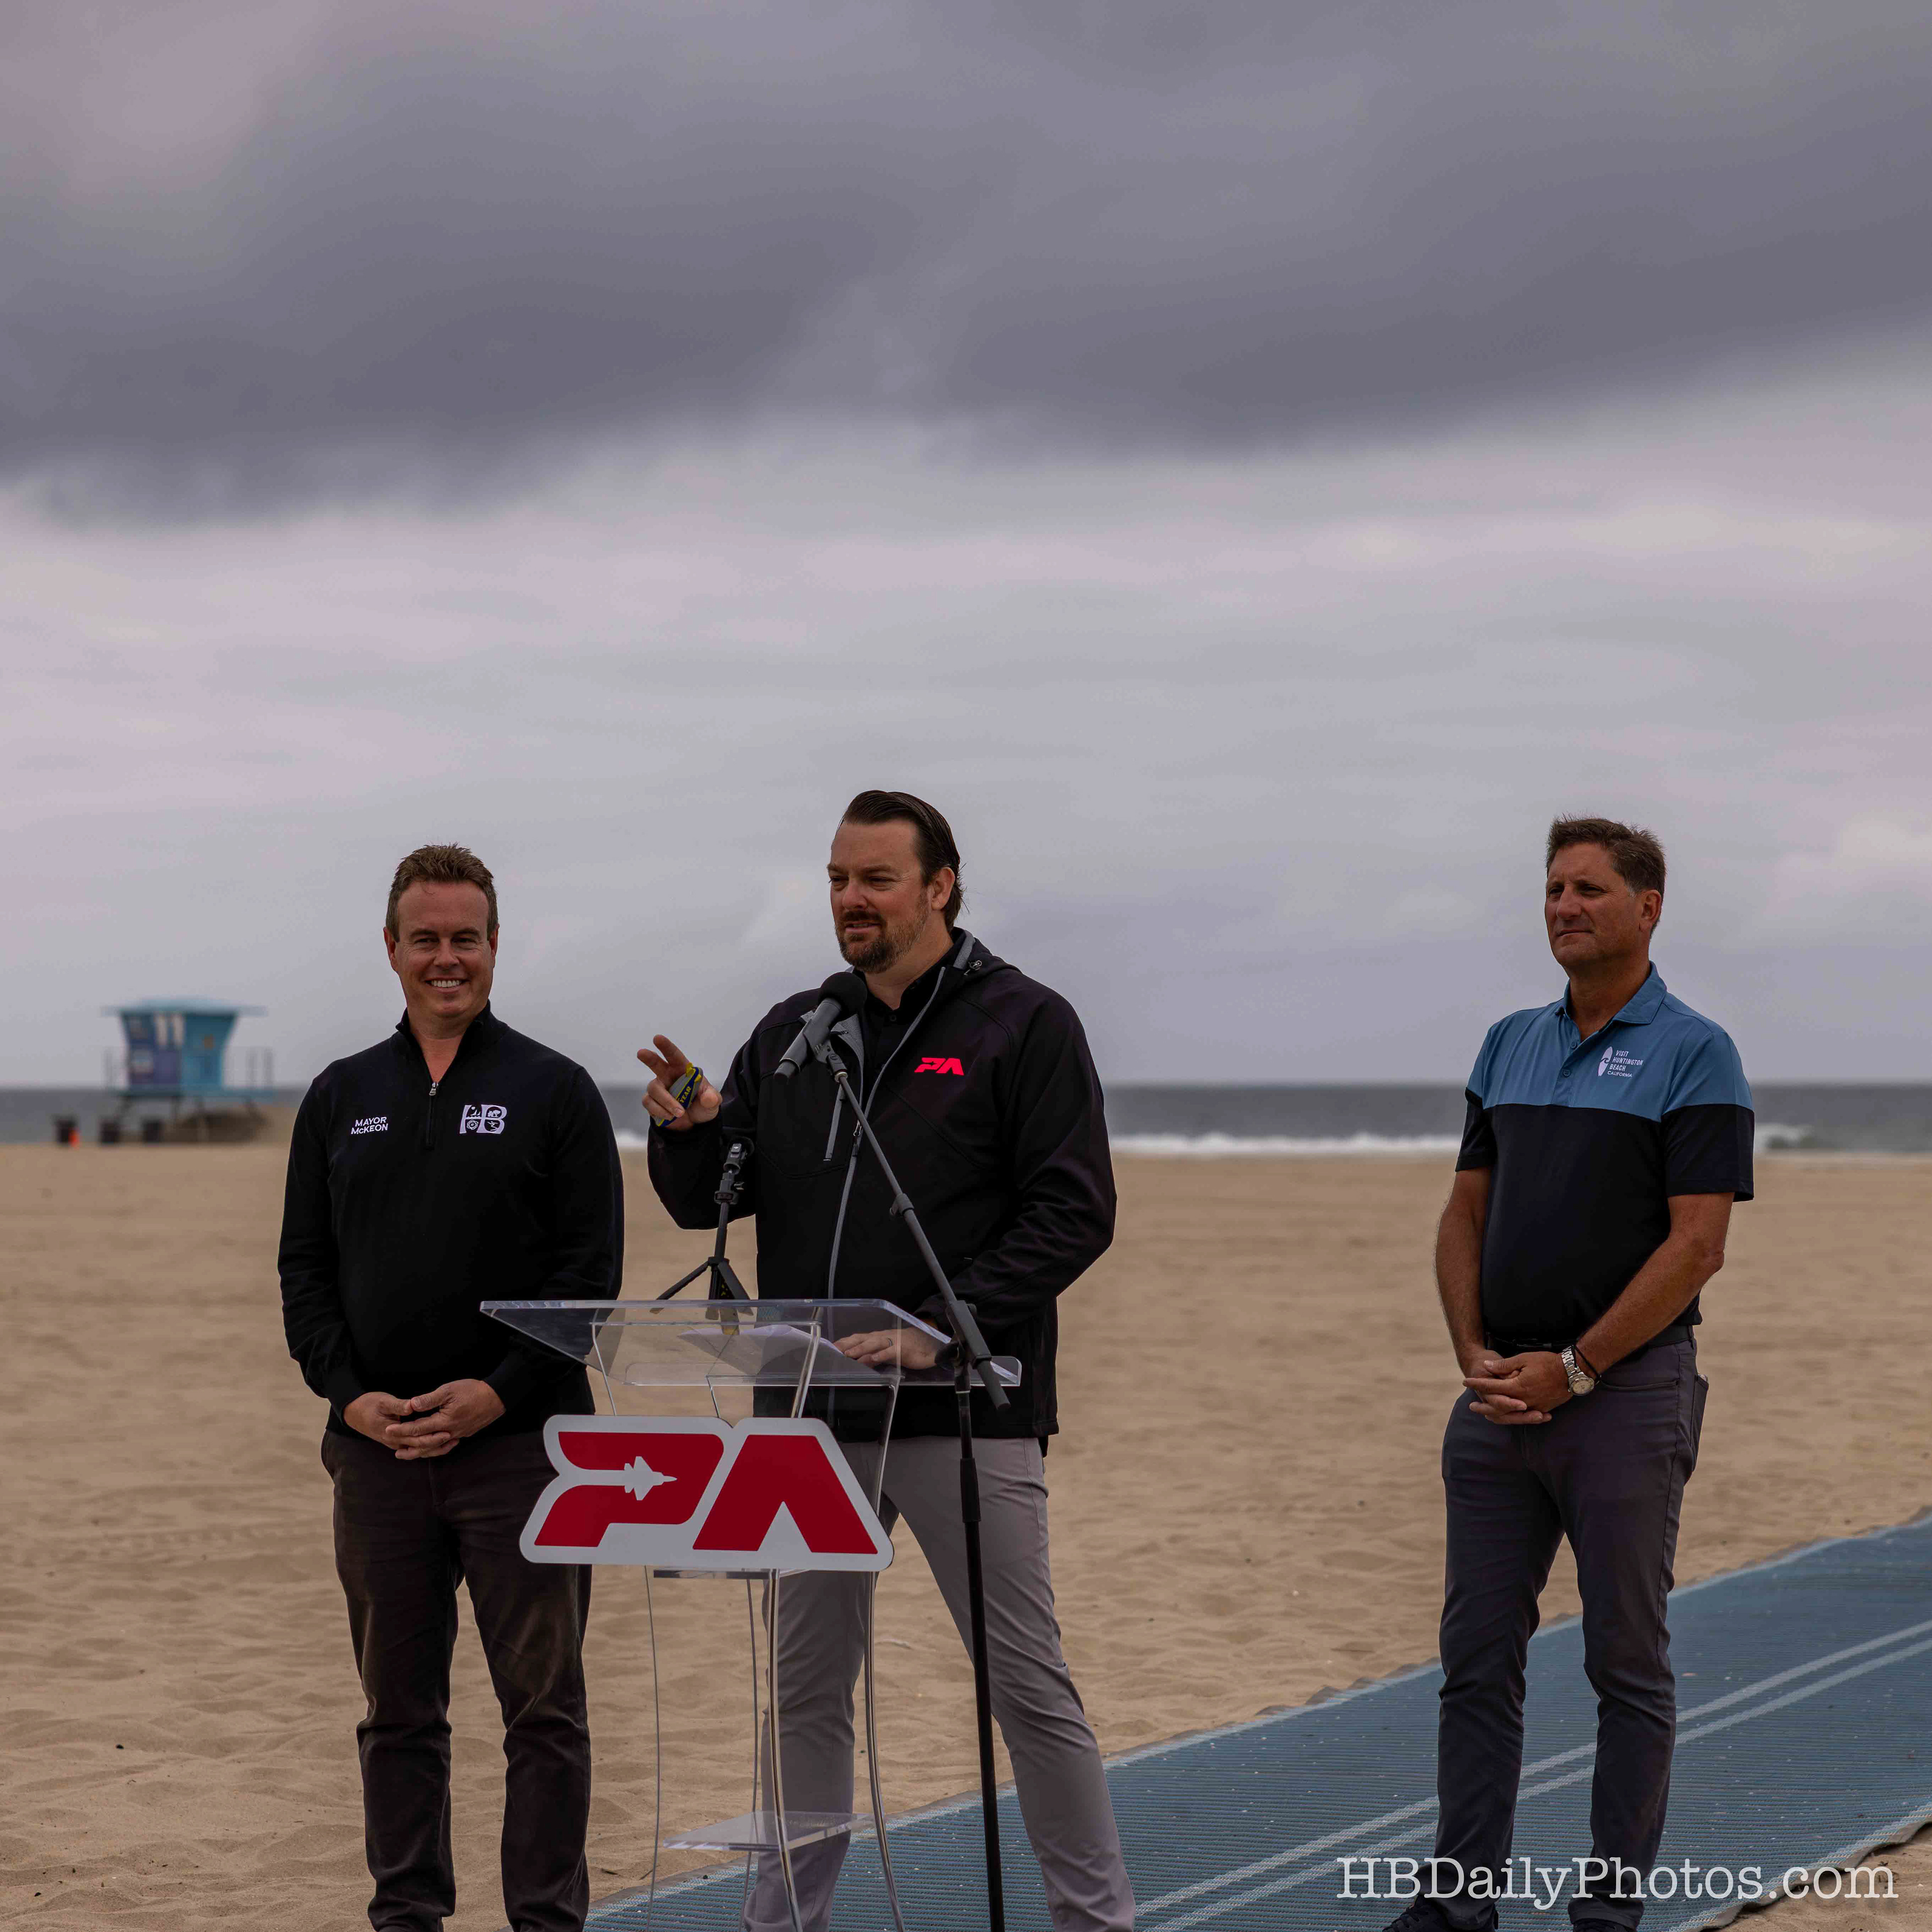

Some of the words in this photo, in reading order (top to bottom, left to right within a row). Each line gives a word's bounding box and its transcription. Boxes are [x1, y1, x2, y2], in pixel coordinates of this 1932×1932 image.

[914, 1058, 964, 1076] PA
[1612, 1057, 1644, 1065] HUNTINGTON
[355, 1117, 387, 1127] MAYOR
[459, 1104, 507, 1134] HB
[351, 1123, 388, 1134] McKEON
[534, 1431, 878, 1554] PA
